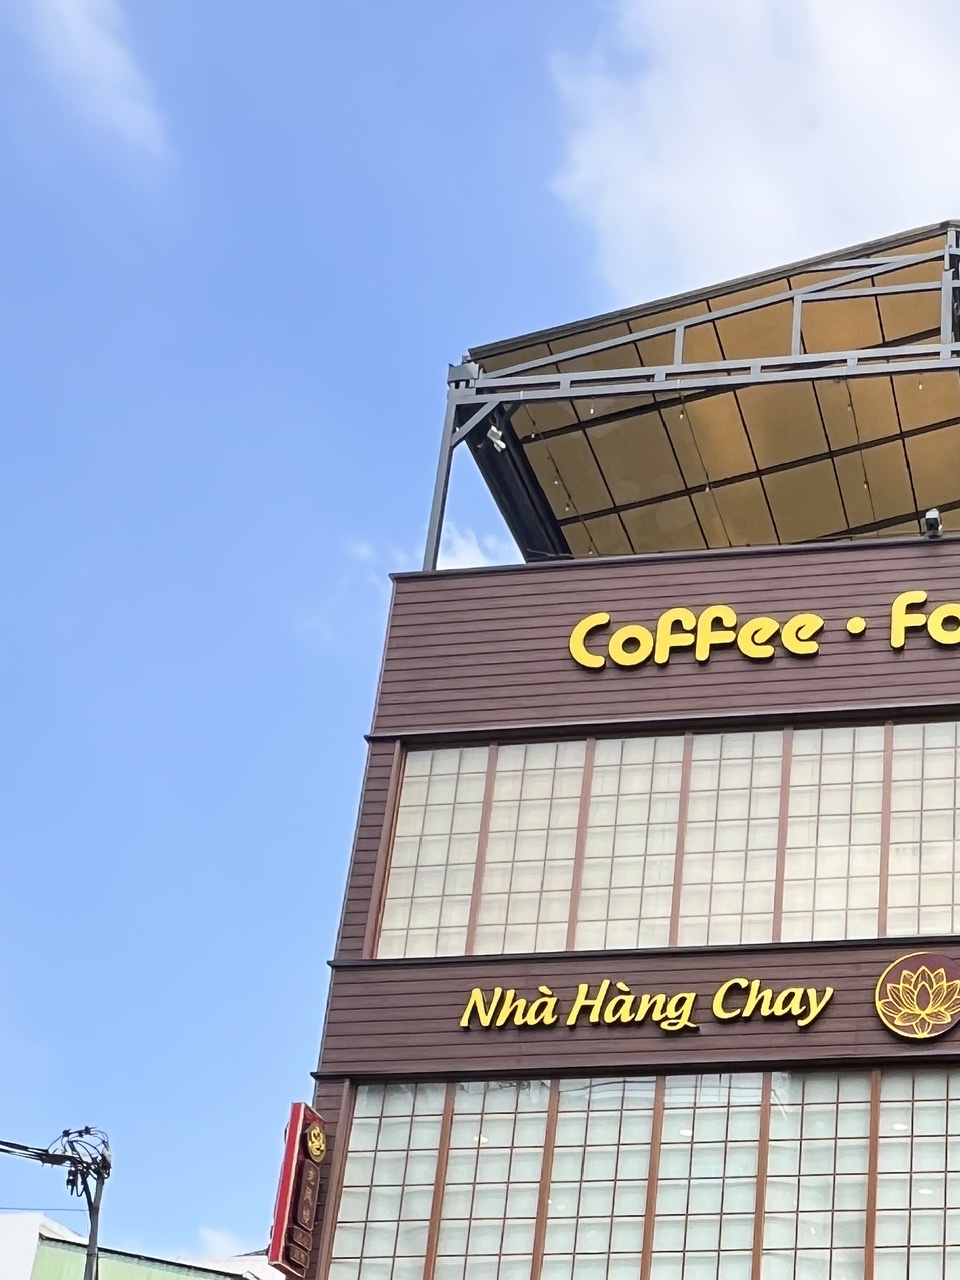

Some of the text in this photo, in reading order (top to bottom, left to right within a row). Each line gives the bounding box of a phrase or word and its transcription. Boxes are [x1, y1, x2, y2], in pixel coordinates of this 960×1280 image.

[568, 603, 824, 669] Coffee
[460, 984, 558, 1029] Nhà
[566, 979, 698, 1031] Hàng
[711, 977, 834, 1027] Chay
